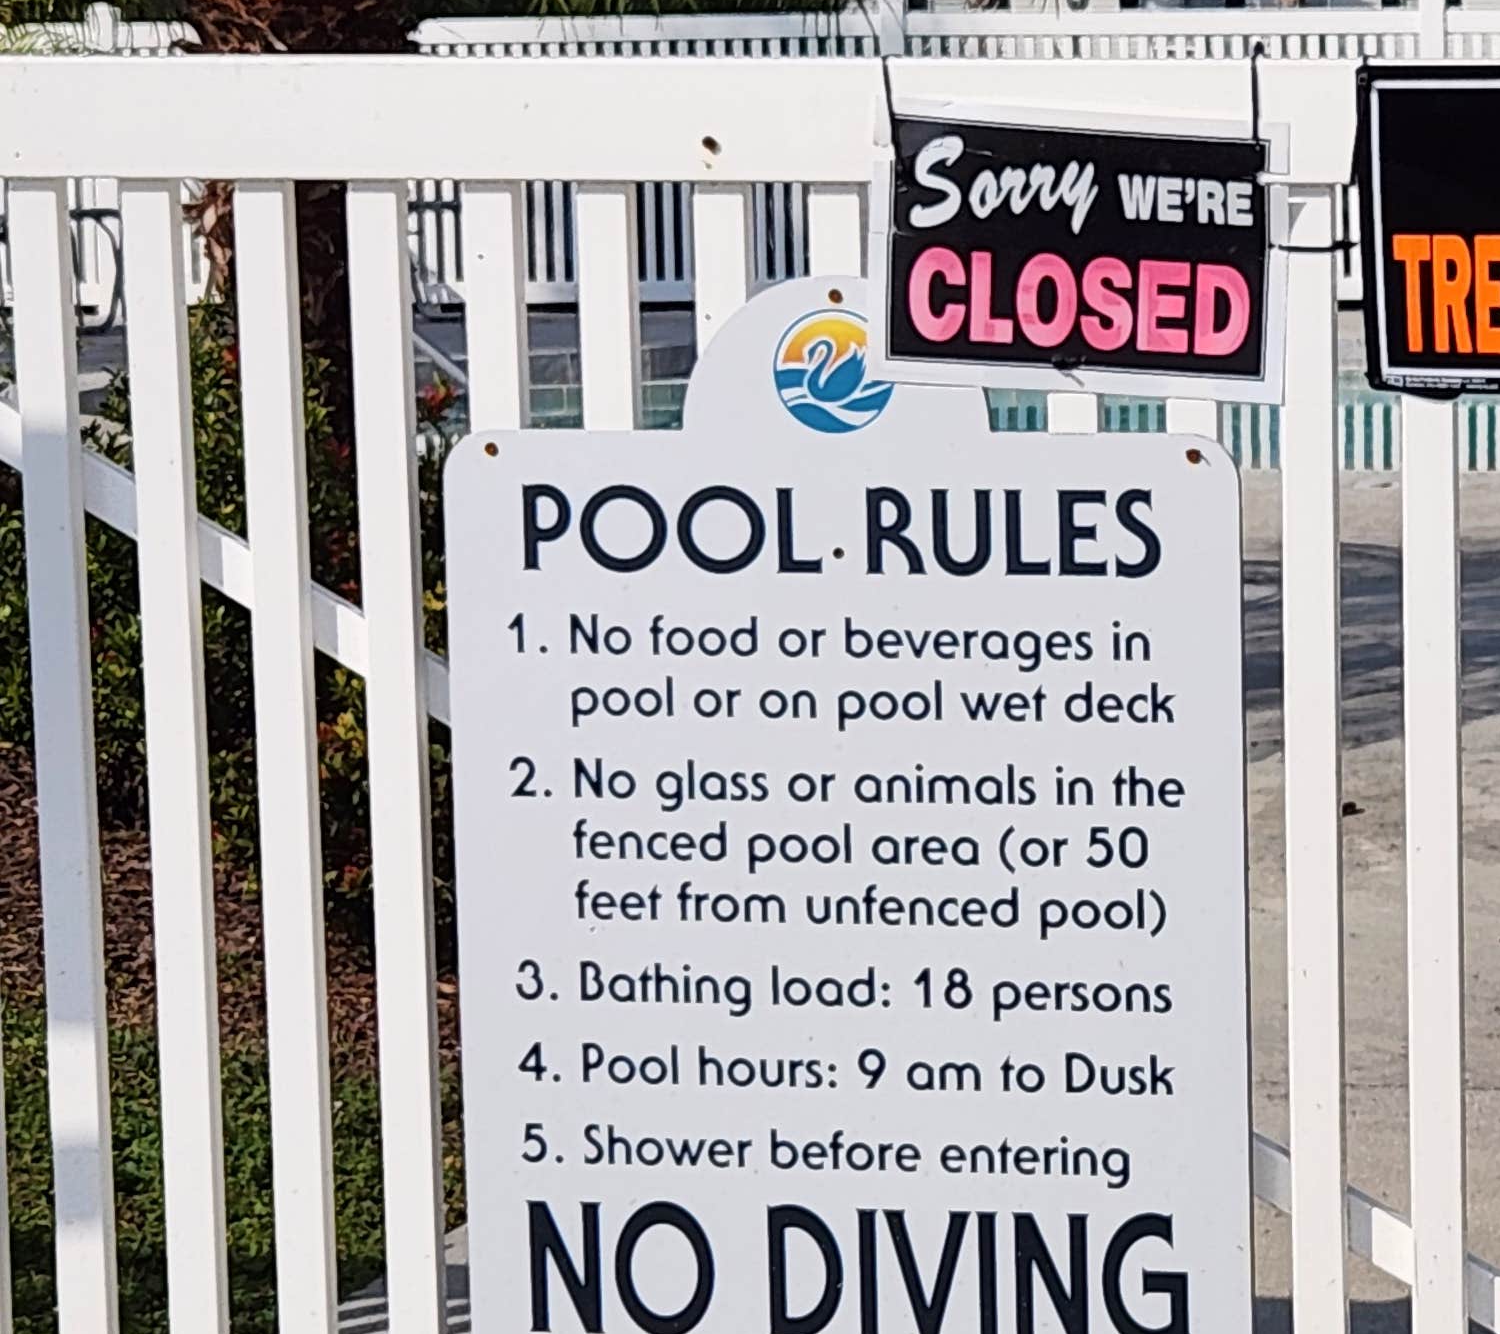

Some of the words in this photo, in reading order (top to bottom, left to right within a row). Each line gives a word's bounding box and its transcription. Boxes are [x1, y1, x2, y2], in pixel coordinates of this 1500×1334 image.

[908, 134, 1100, 235] Sorry
[1116, 173, 1255, 227] WE'RE
[908, 246, 1251, 357] CLOSED
[521, 482, 823, 576] POOL
[864, 485, 1163, 580] RULES
[506, 611, 549, 656] 1.
[568, 612, 633, 657] No
[648, 613, 759, 658] food
[777, 627, 828, 659] or
[843, 616, 1094, 674] beverages
[1111, 619, 1152, 662] in
[570, 674, 675, 729] pool
[692, 687, 743, 719] or
[758, 688, 818, 720] on
[836, 678, 944, 733] pool
[958, 684, 1048, 724] wet
[1063, 680, 1176, 725] deck
[508, 755, 554, 799] 2.
[572, 756, 638, 800] No
[654, 758, 770, 814] glass
[786, 771, 837, 804] or
[853, 762, 1038, 807] animals
[1054, 764, 1095, 807] in
[1111, 764, 1186, 809] the
[571, 817, 728, 863] fenced
[746, 821, 853, 875] pool
[870, 834, 981, 867] area
[998, 824, 1070, 875] (or
[1085, 825, 1150, 870] 50
[573, 878, 663, 922] feet
[675, 880, 787, 925] from
[805, 883, 1020, 929] unfenced
[1038, 887, 1168, 942] pool)
[514, 958, 560, 1002] 3.
[578, 959, 753, 1019] Bathing
[770, 964, 892, 1009] load:
[913, 966, 974, 1011] 18
[991, 979, 1174, 1023] persons
[517, 1040, 562, 1084] 4.
[580, 1041, 680, 1086] Pool
[697, 1044, 838, 1090] hours:
[856, 1047, 887, 1090] 9
[905, 1060, 982, 1093] am
[999, 1055, 1047, 1094] to
[1064, 1050, 1176, 1097] Dusk
[520, 1121, 565, 1165] 5.
[582, 1122, 754, 1170] Shower
[769, 1127, 923, 1173] before
[939, 1134, 1131, 1190] entering
